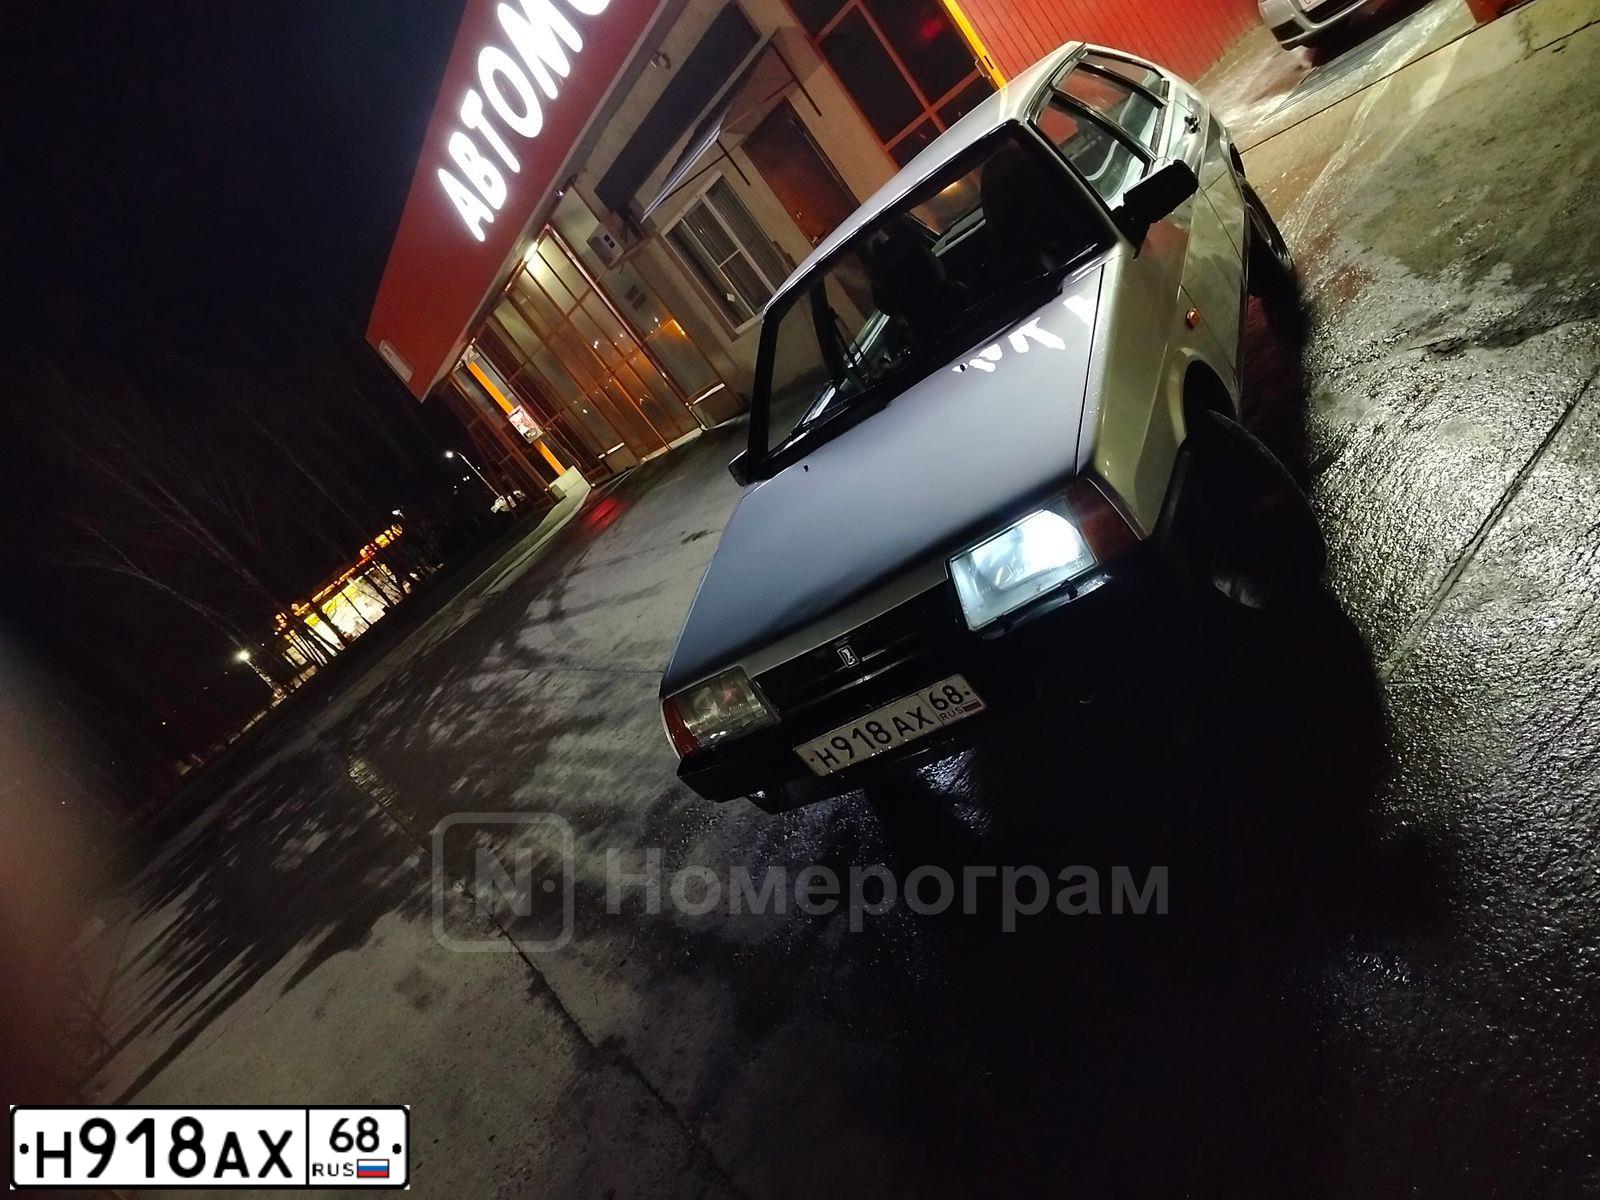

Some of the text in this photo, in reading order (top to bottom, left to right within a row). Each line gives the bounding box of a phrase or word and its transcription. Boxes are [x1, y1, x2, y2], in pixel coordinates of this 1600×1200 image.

[814, 685, 964, 768] Н918АХ 68
[940, 706, 965, 721] RUS
